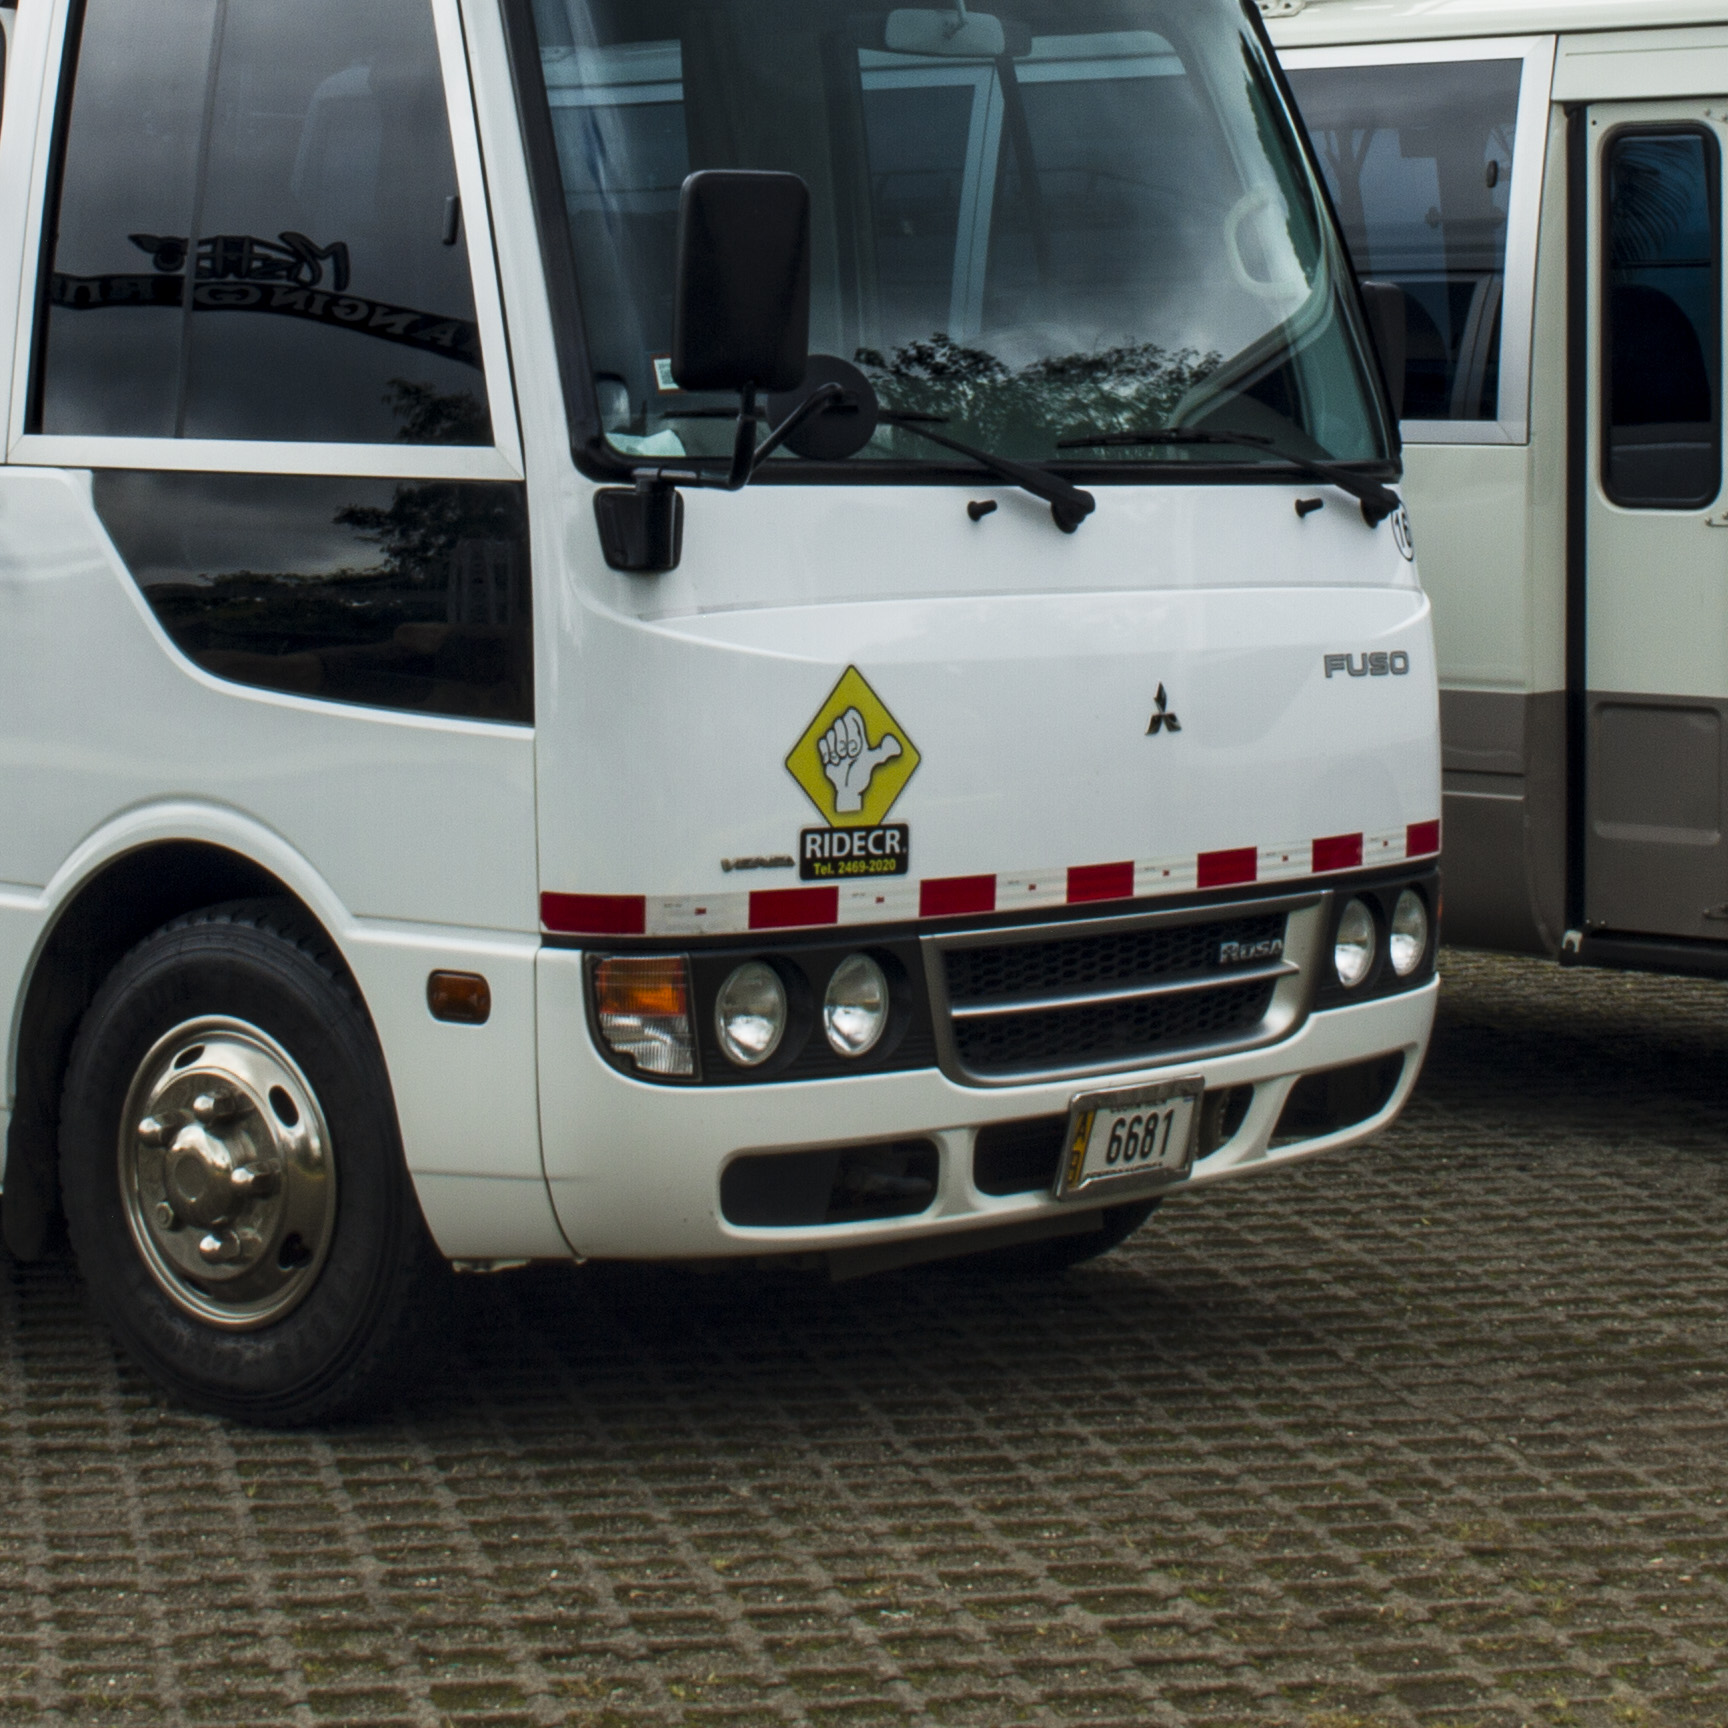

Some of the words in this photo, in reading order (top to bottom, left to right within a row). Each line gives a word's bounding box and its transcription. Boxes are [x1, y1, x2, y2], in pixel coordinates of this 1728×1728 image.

[1324, 651, 1410, 679] FUSO
[805, 829, 901, 859] RIDECR
[813, 862, 835, 875] Tel.
[838, 859, 897, 874] 2469-2020
[1106, 1108, 1174, 1165] 6681
